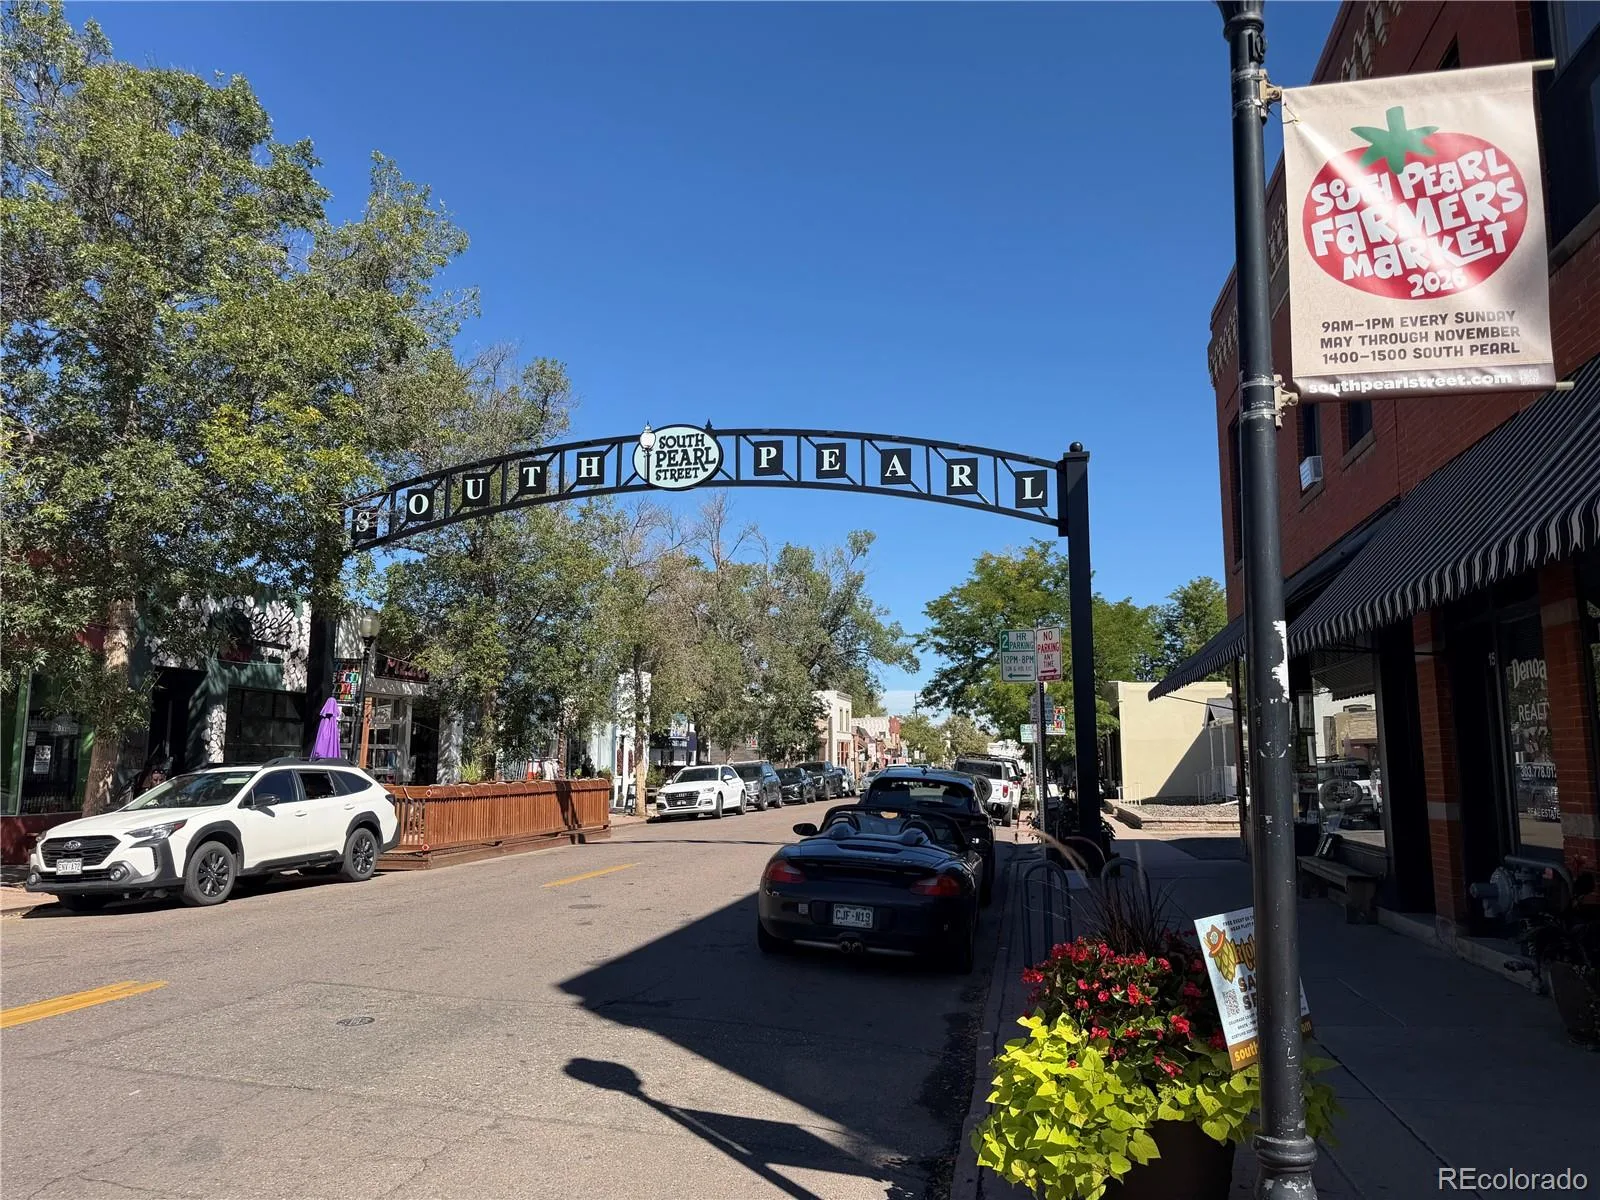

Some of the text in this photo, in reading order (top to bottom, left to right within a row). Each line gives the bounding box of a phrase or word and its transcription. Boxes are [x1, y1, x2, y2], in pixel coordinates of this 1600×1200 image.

[1400, 313, 1448, 328] EVERY
[1454, 310, 1516, 324] SUNDAY
[1320, 326, 1520, 349] MAY THROUGH NOVEMBER
[1413, 345, 1463, 359] SOUTH
[1469, 342, 1520, 356] PEARL
[1308, 374, 1512, 397] southpearlstreet.com
[658, 433, 705, 449] SOUTH
[655, 446, 716, 472] PEARL
[655, 467, 700, 482] STREET
[1016, 633, 1027, 641] HR
[1043, 631, 1053, 641] NO
[1010, 641, 1034, 650] PARKING
[1037, 642, 1060, 653] PARKING
[1043, 660, 1054, 668] TIME
